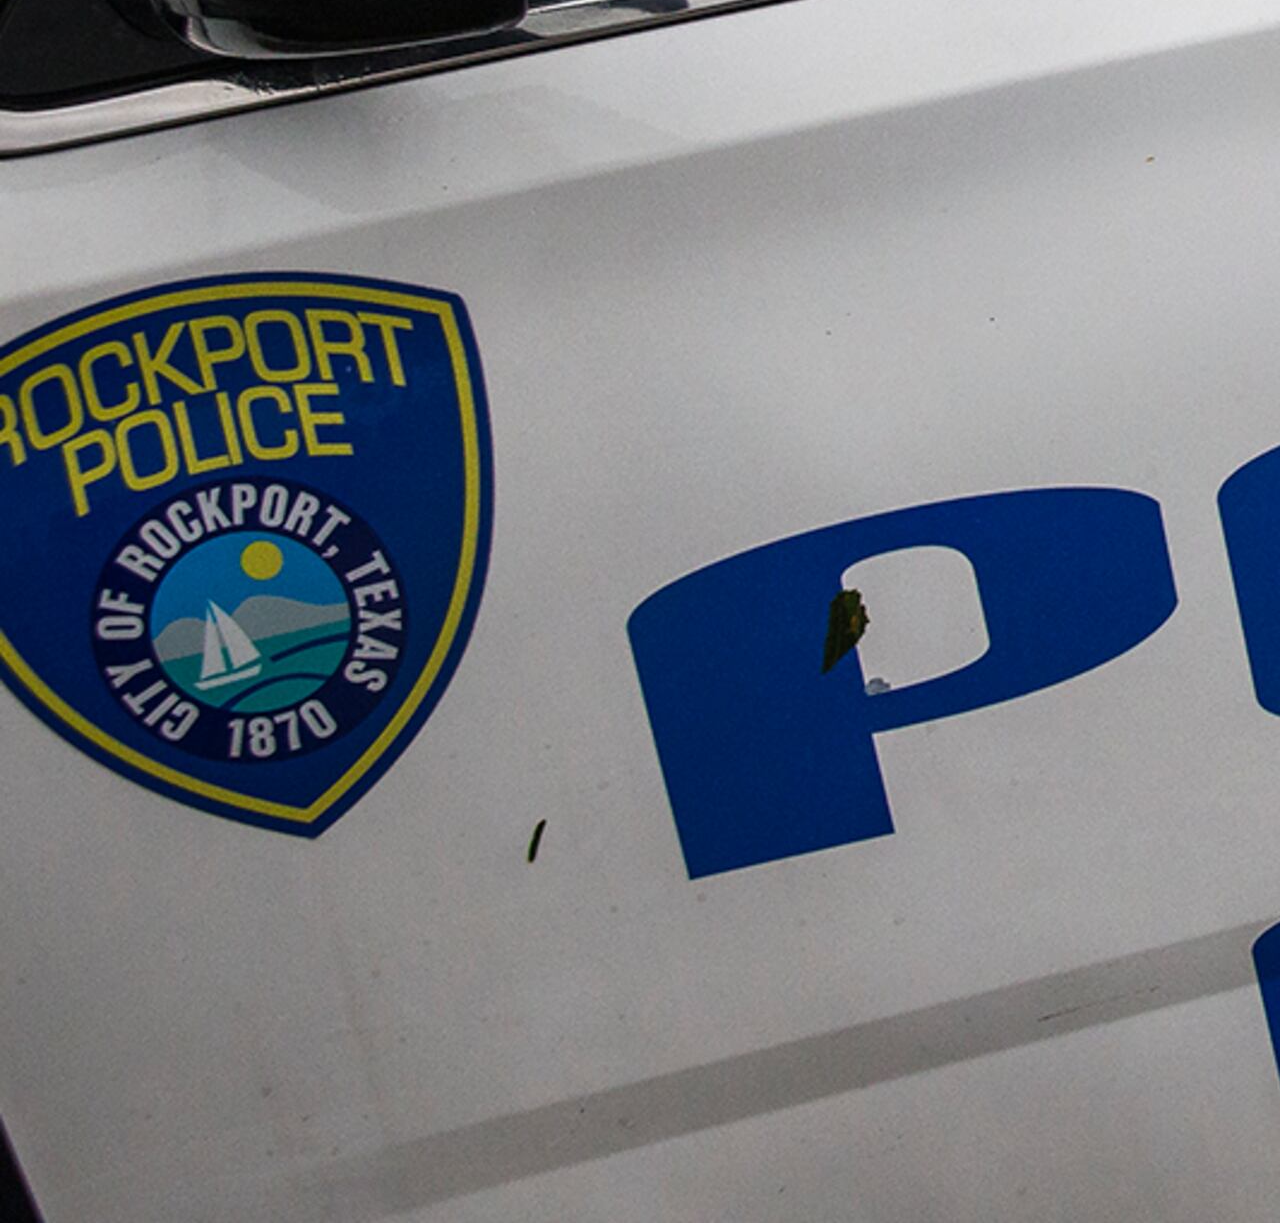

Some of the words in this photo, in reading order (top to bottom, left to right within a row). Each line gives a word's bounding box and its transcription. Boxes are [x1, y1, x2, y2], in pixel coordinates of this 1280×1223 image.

[62, 382, 353, 517] POLICE
[96, 589, 145, 641] OF
[344, 549, 403, 693] TEXAS
[105, 658, 200, 742] CITY
[227, 699, 338, 758] 1870
